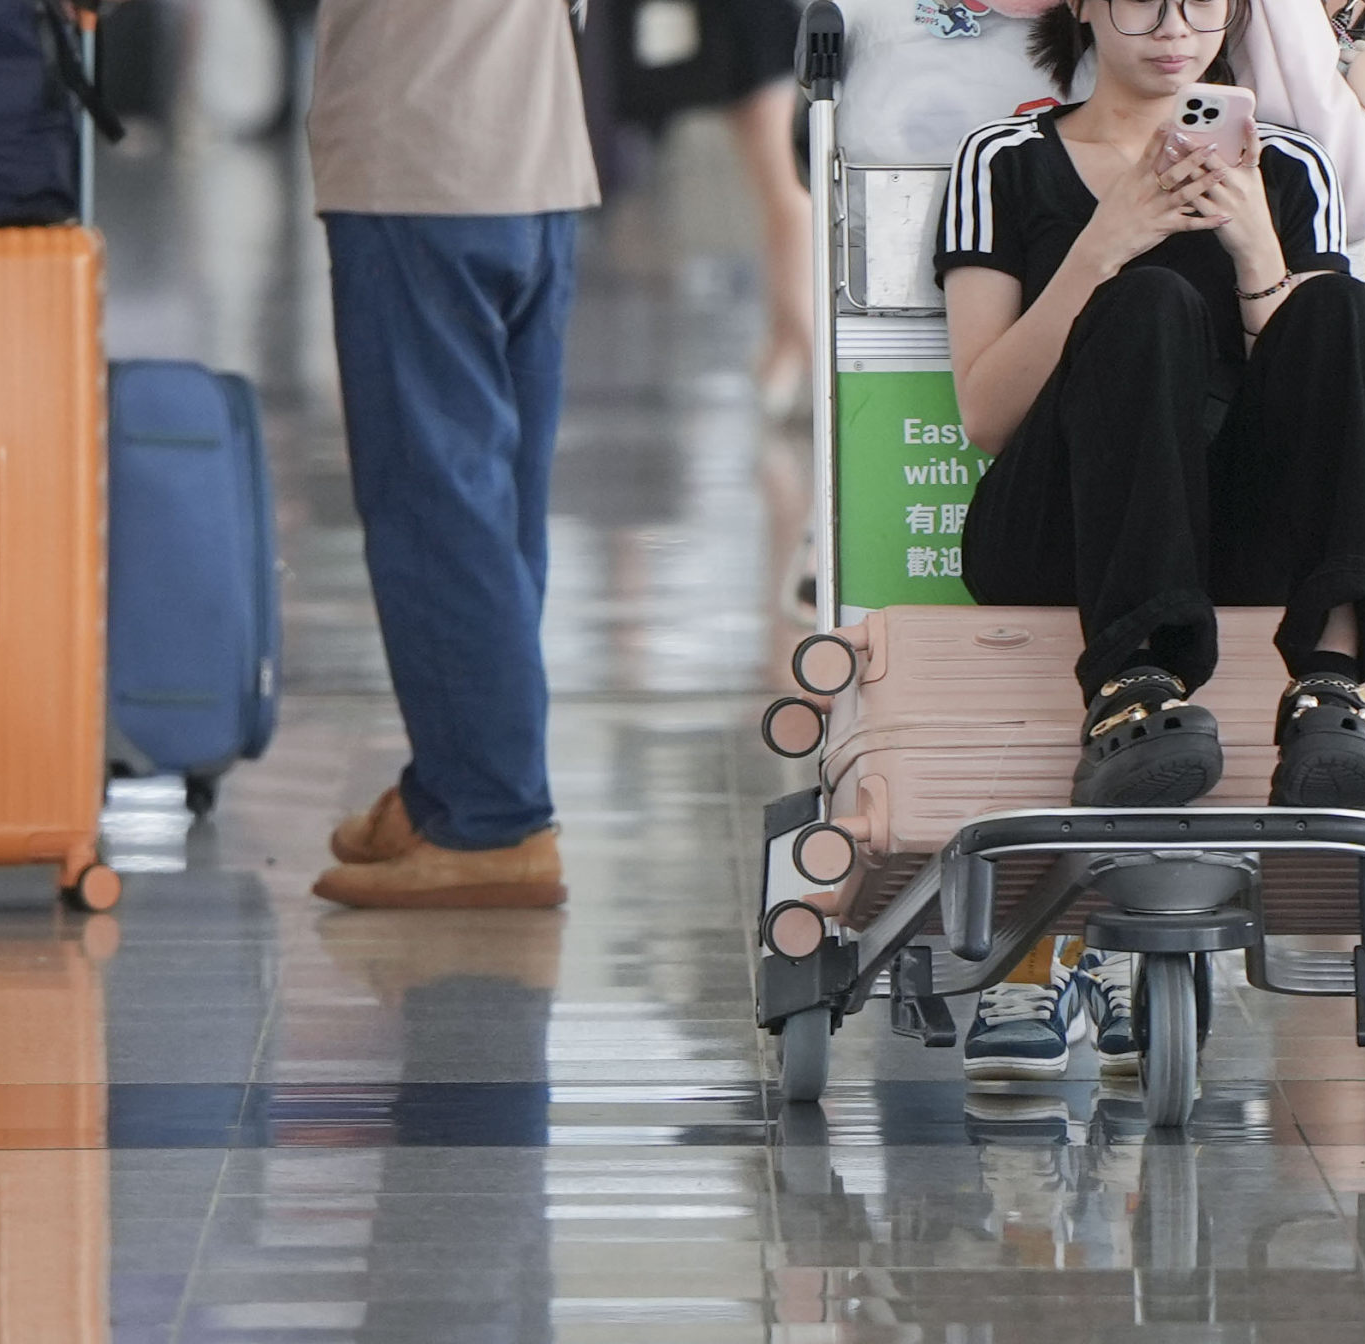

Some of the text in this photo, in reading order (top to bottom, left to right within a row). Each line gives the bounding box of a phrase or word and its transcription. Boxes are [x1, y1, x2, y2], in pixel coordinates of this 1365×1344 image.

[914, 15, 940, 26] HOPPS
[916, 3, 938, 14] JUDY
[903, 418, 971, 451] Easy
[903, 457, 969, 485] with
[905, 503, 969, 535] 有朋
